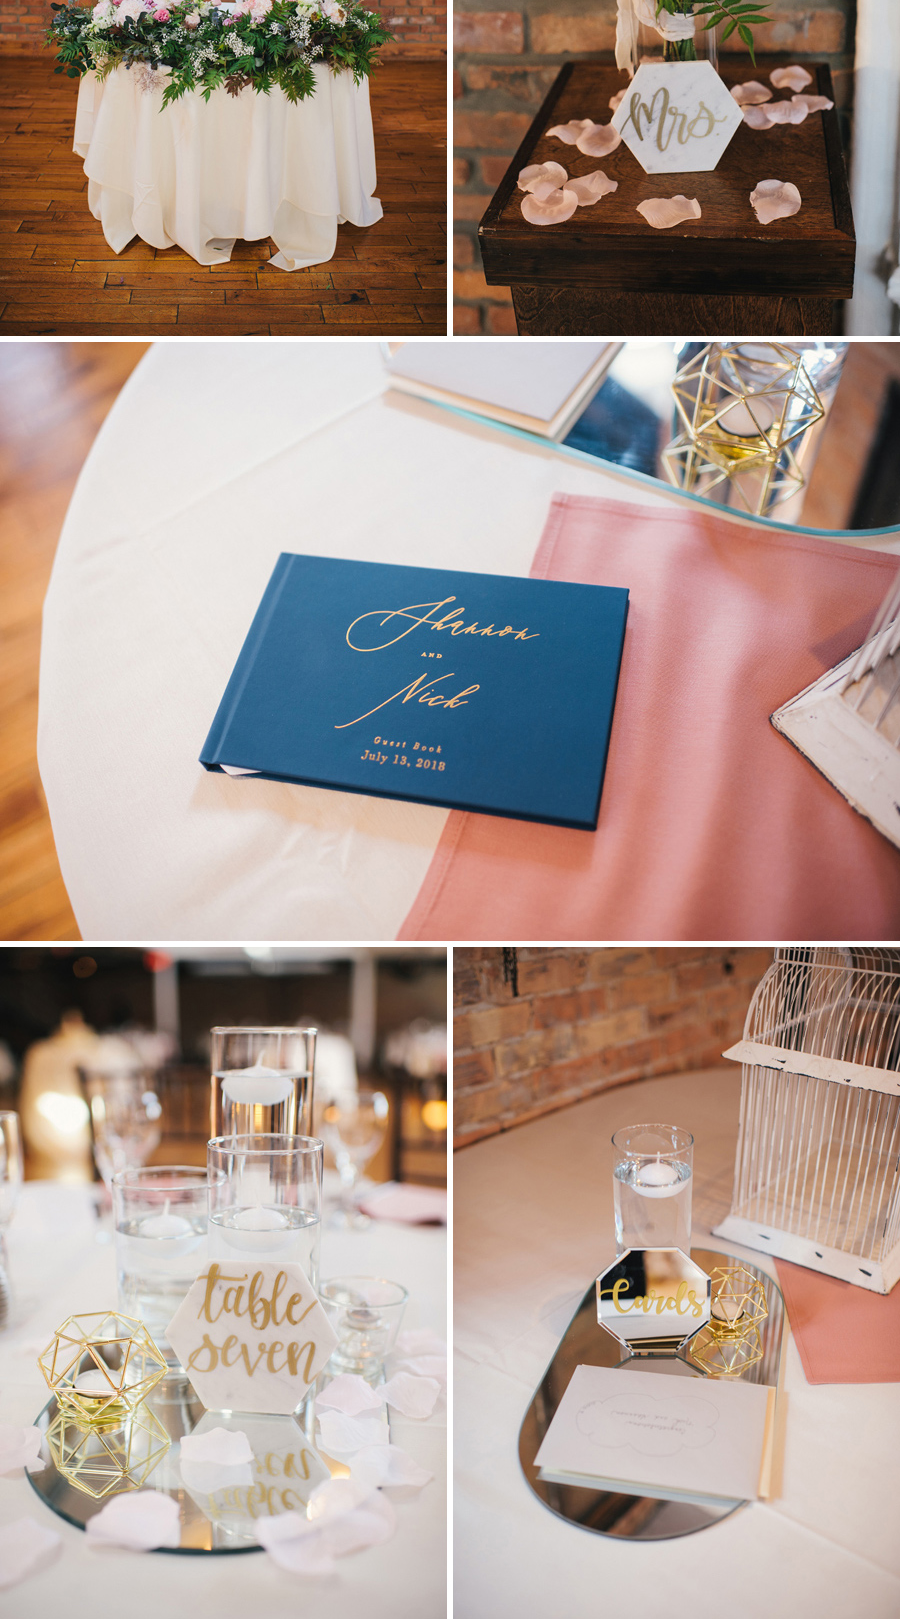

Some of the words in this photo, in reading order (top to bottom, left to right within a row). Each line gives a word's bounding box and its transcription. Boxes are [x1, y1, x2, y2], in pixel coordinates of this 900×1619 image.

[620, 86, 728, 152] Mrs.
[346, 595, 540, 652] Shannon
[420, 651, 443, 659] AND
[334, 672, 480, 729] Nick
[360, 749, 389, 765] July
[392, 754, 411, 769] 13,
[415, 757, 446, 772] 2018
[373, 735, 407, 749] Guest
[412, 741, 443, 754] Book
[197, 1263, 318, 1330] table
[599, 1278, 706, 1318] Cards
[185, 1333, 322, 1385] seven
